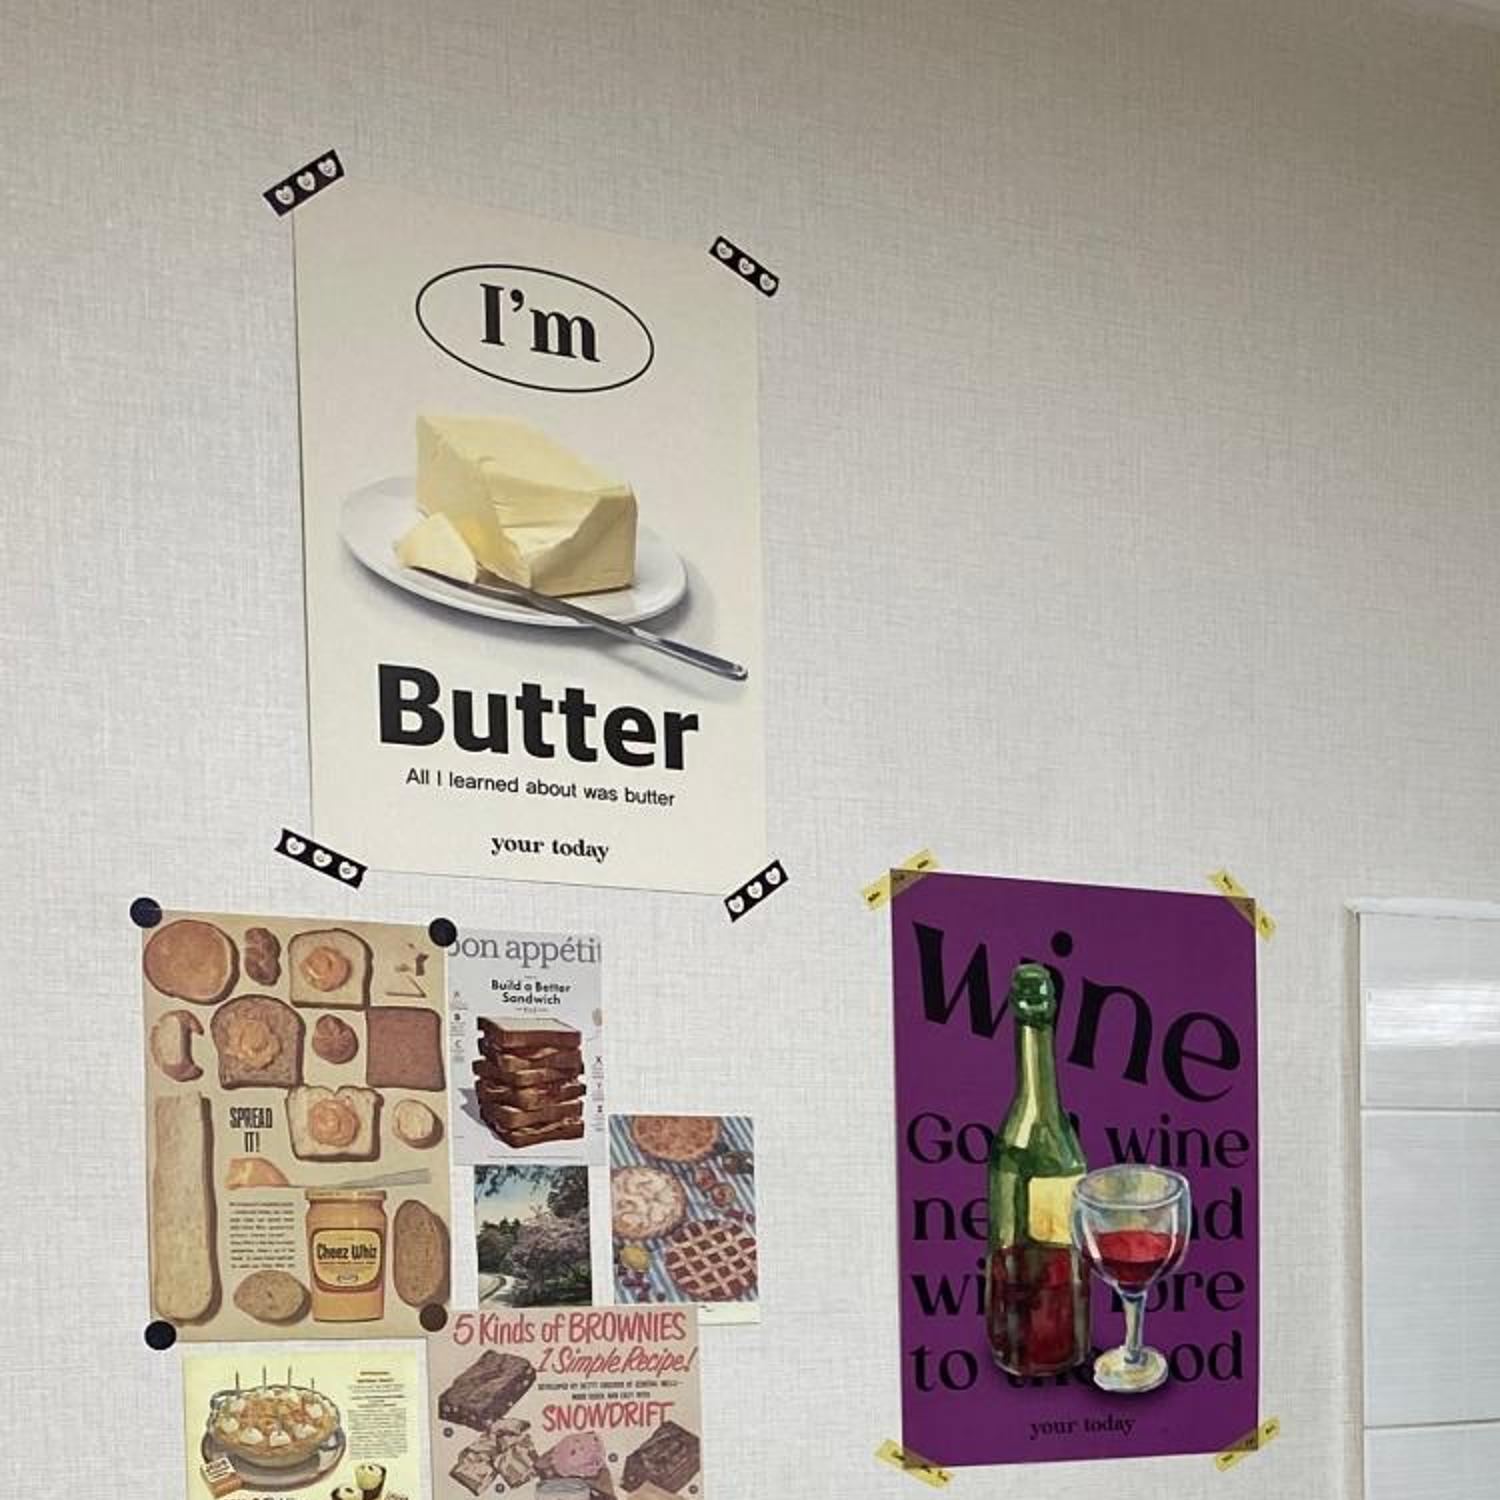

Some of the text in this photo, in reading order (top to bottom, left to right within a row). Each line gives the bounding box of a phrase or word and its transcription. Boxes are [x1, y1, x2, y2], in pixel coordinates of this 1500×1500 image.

[479, 283, 600, 363] I’m
[378, 663, 700, 771] Butter
[406, 768, 676, 808] All I learned about was butter
[490, 835, 610, 863] your today
[491, 979, 571, 994] Build a Better
[502, 991, 561, 1006] Sandwich
[229, 1107, 273, 1129] SPREAD
[1105, 1113, 1251, 1168] wine
[453, 1311, 687, 1345] 5 Kinds of BROWNIES
[552, 1346, 624, 1379] Simple
[622, 1345, 699, 1379] Recipe!
[912, 1344, 979, 1393] to
[542, 1401, 675, 1432] SNOWDRIFT
[1030, 1413, 1137, 1440] your today
